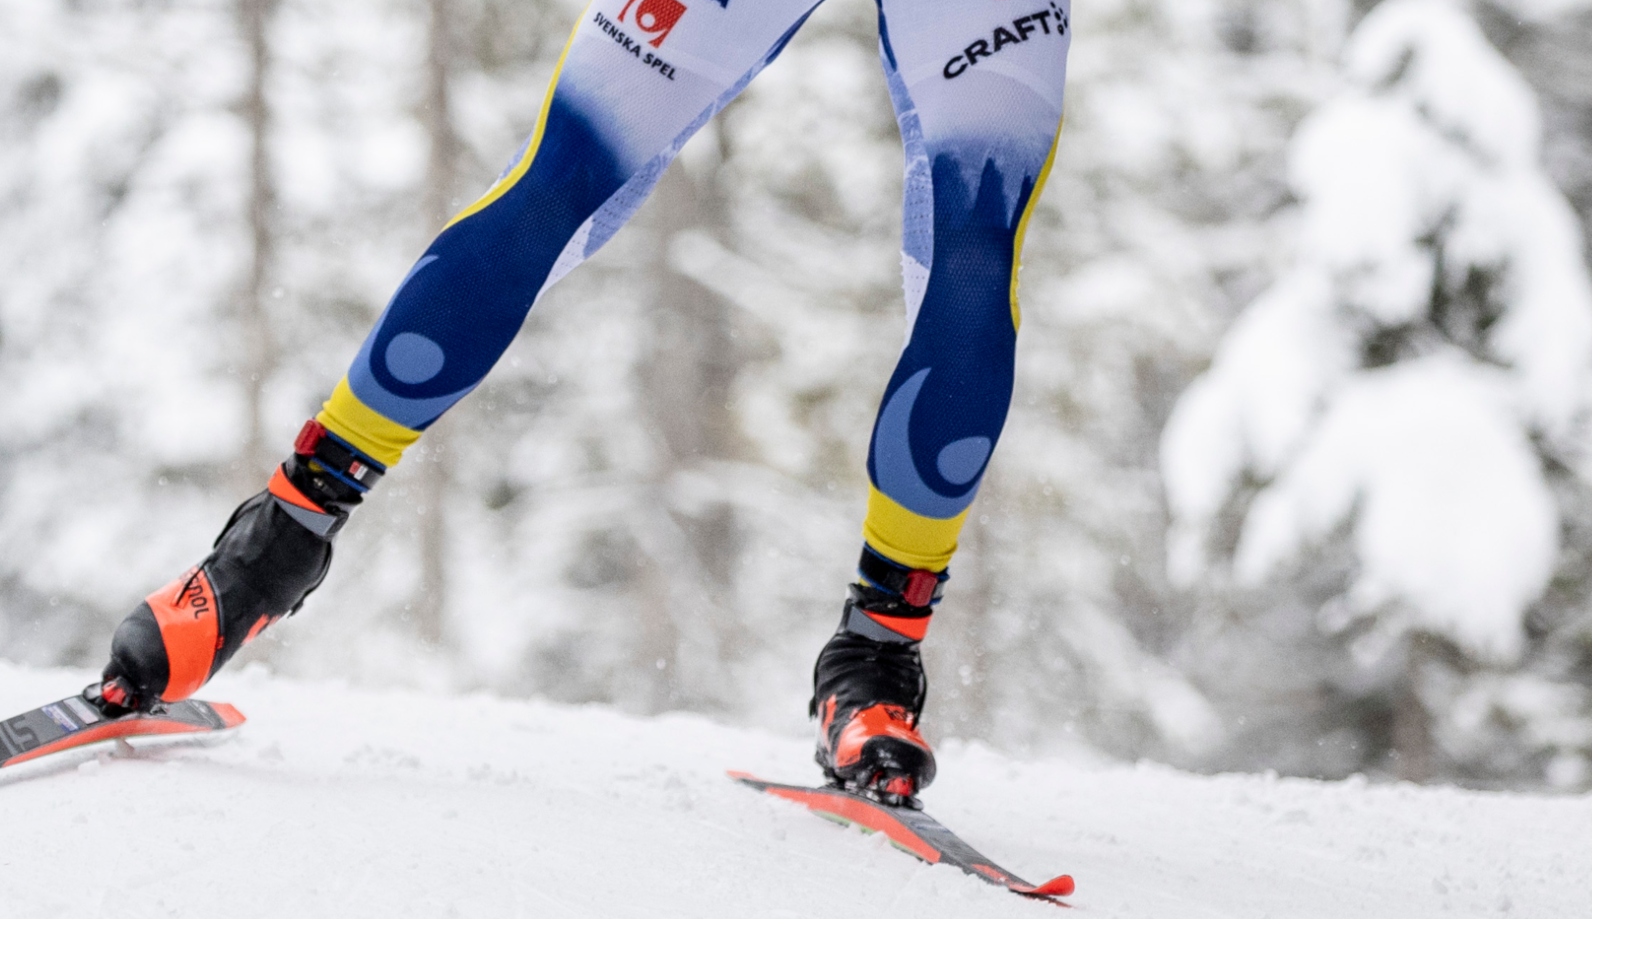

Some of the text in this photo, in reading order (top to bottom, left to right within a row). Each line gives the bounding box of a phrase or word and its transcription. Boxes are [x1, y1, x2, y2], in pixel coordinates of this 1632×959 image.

[593, 11, 677, 81] SVENSKA SPEL
[943, 9, 1052, 80] CRAFT
